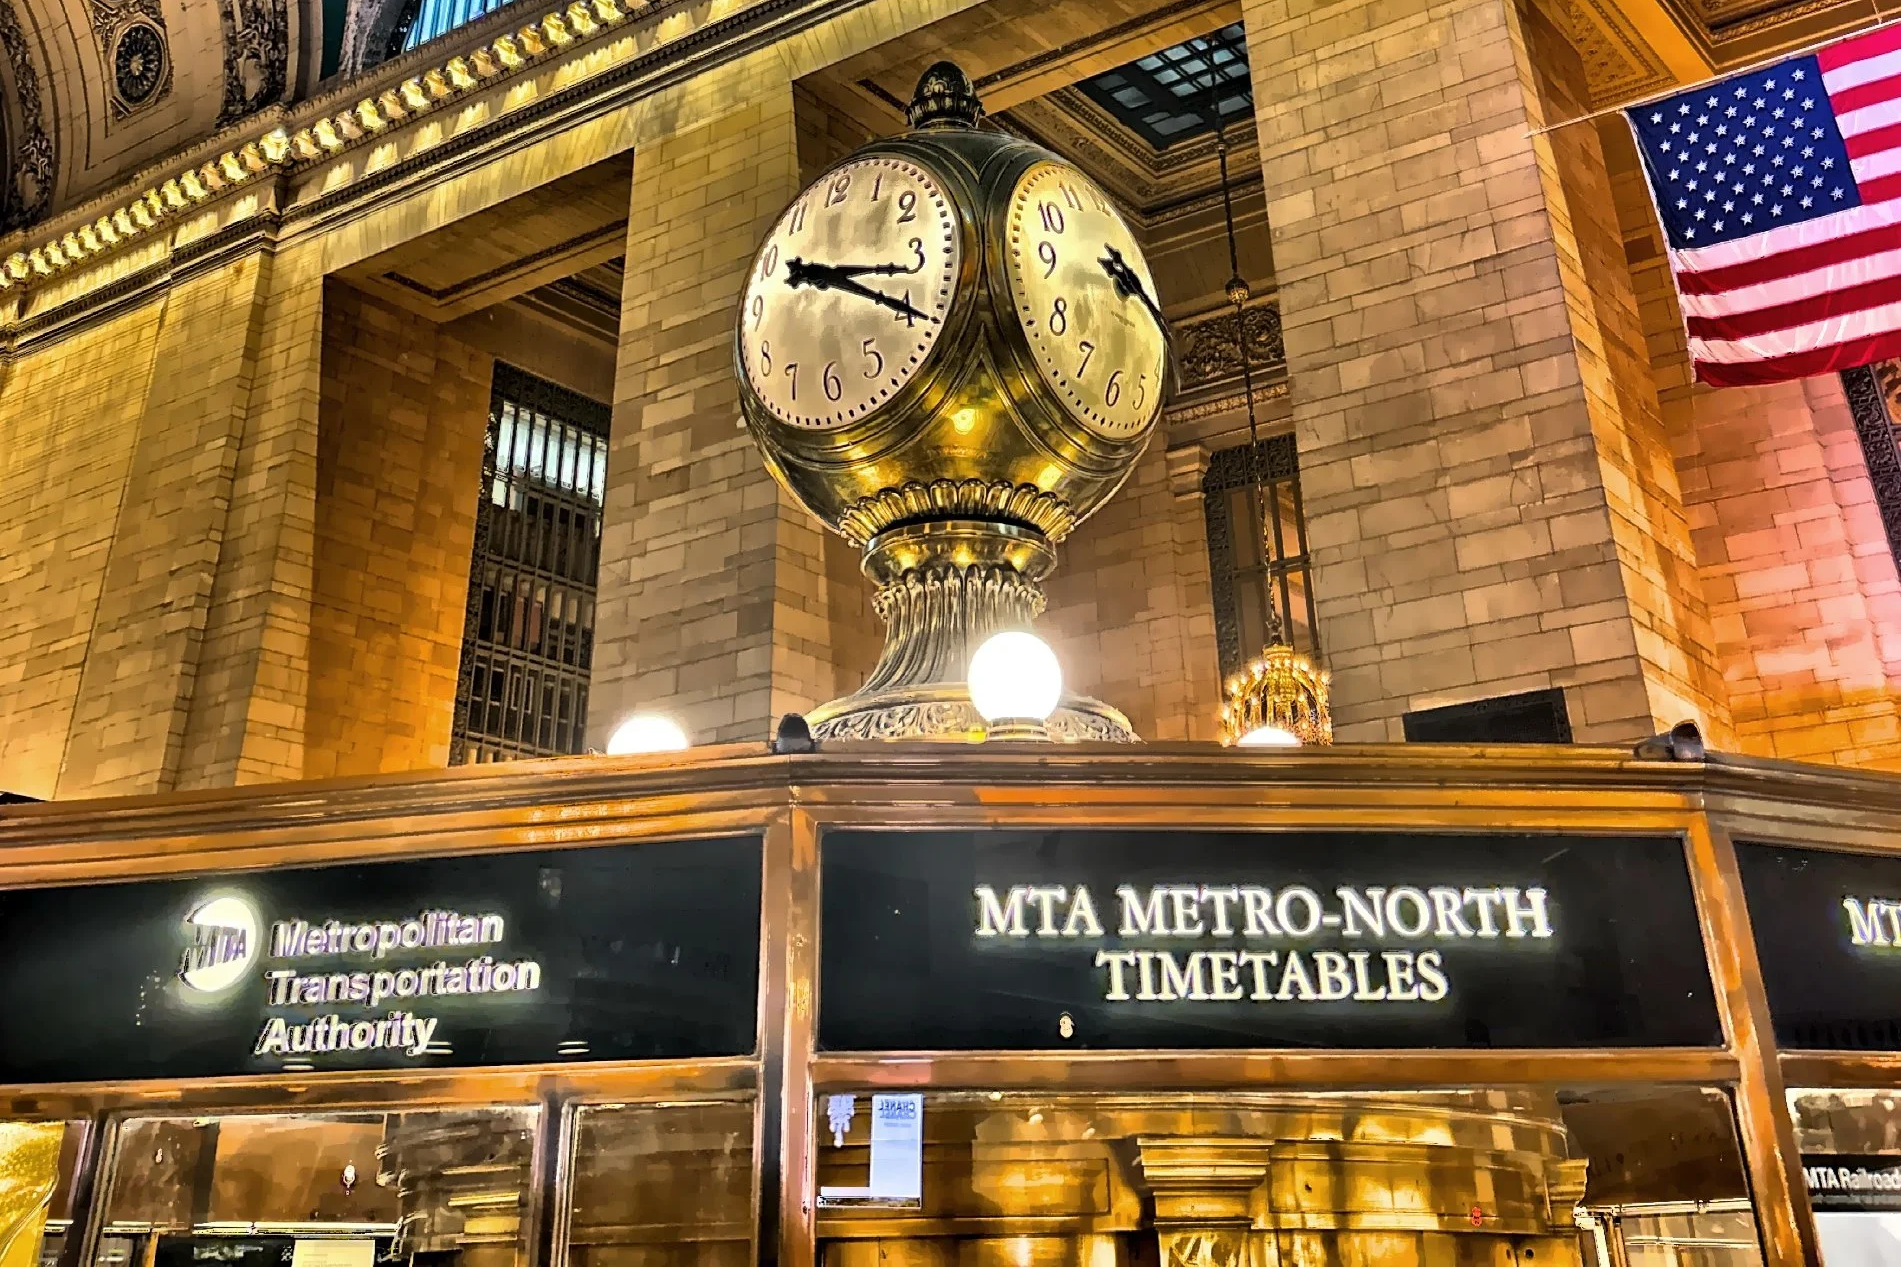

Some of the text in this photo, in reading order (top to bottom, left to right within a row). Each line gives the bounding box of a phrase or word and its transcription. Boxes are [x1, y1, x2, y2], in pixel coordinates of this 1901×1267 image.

[824, 174, 850, 209] 12
[870, 172, 884, 202] 1
[1058, 181, 1084, 212] 11
[788, 202, 808, 237] 11
[896, 190, 916, 225] 2
[1037, 199, 1065, 235] 10
[760, 243, 779, 282] 10
[906, 237, 926, 275] 3
[1038, 241, 1057, 280] 9
[752, 295, 764, 333] 9
[894, 289, 918, 328] 4
[1049, 297, 1067, 337] 8
[760, 339, 773, 378] 8
[862, 337, 884, 380] 5
[1076, 341, 1095, 379] 7
[784, 362, 799, 401] 7
[822, 360, 843, 402] 6
[1105, 370, 1125, 407] 6
[1132, 373, 1147, 411] 5
[974, 885, 1554, 938] MTA METRO-NORTH
[269, 909, 505, 959] Metropolitan
[265, 956, 541, 1008] Transportation
[1095, 949, 1450, 1002] TIMETABLES
[254, 1010, 438, 1056] Authority
[1802, 1166, 1840, 1189] MTA
